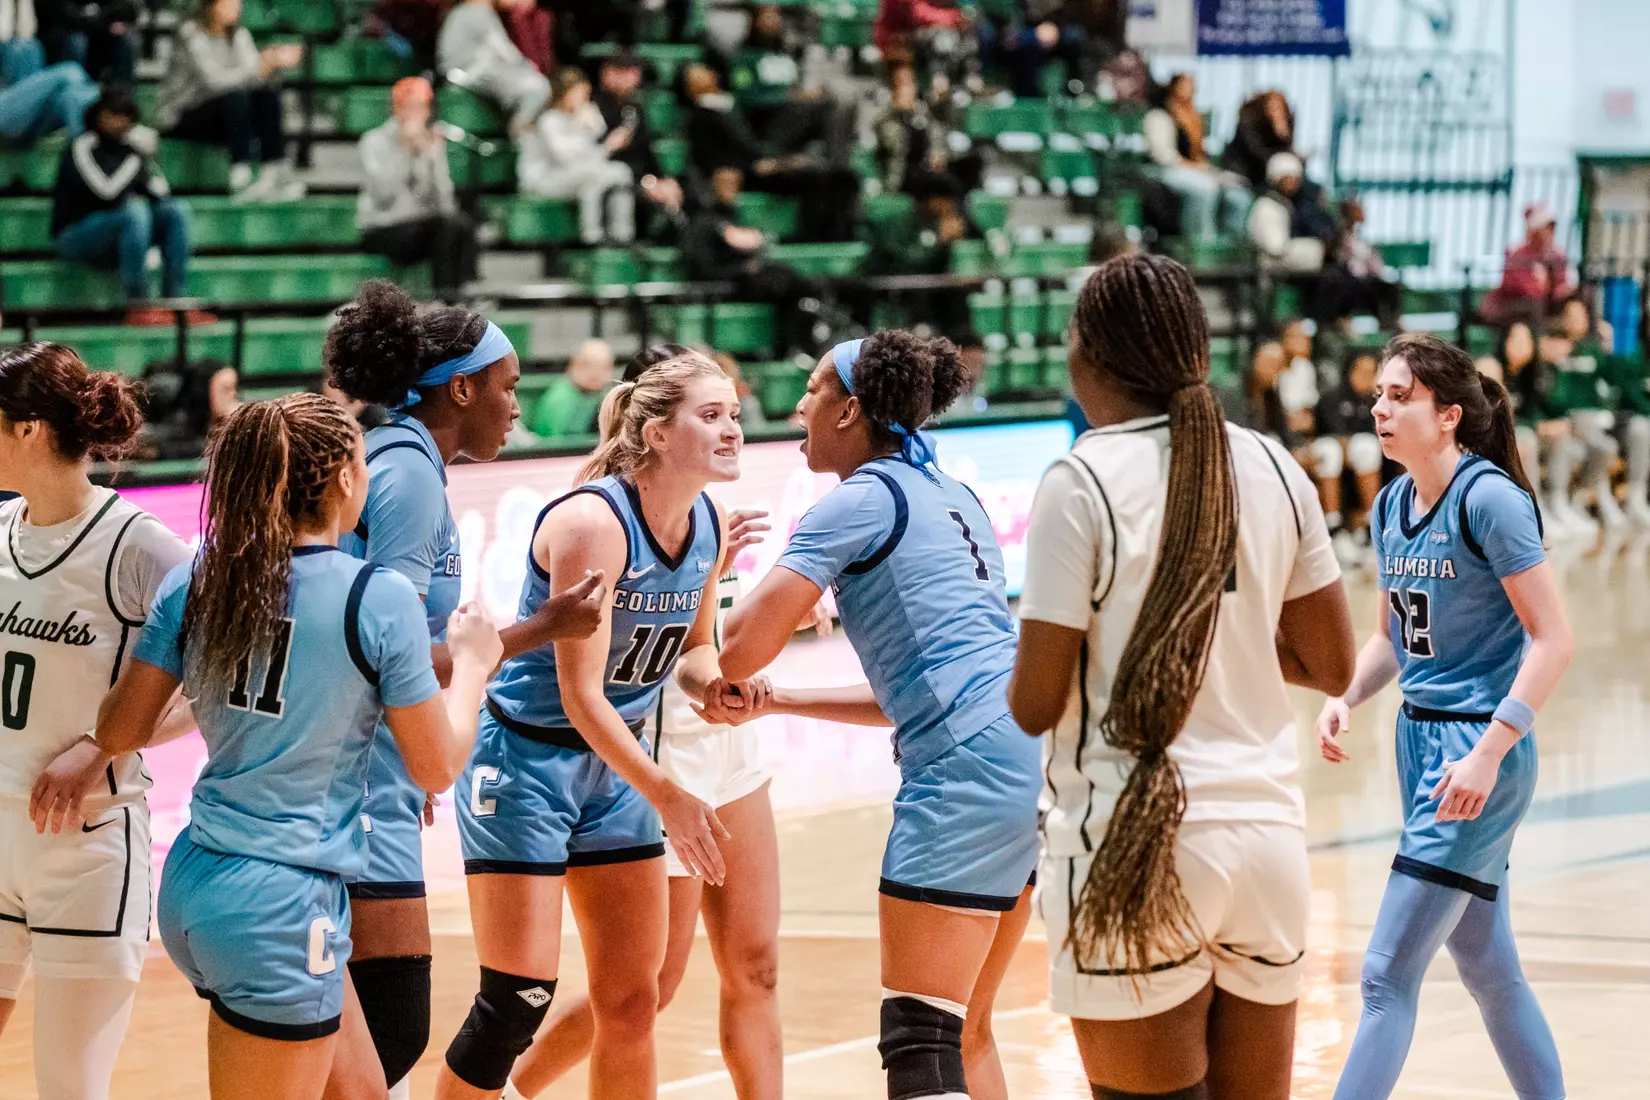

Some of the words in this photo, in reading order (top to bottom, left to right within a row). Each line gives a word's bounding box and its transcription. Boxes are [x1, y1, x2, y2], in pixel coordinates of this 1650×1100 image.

[946, 508, 991, 582] 1
[1385, 555, 1456, 579] LUMBIA
[0, 601, 97, 646] hawks
[1389, 587, 1435, 658] 12
[609, 623, 690, 686] 10
[2, 651, 35, 730] 0
[471, 765, 501, 818] C
[307, 915, 337, 977] C
